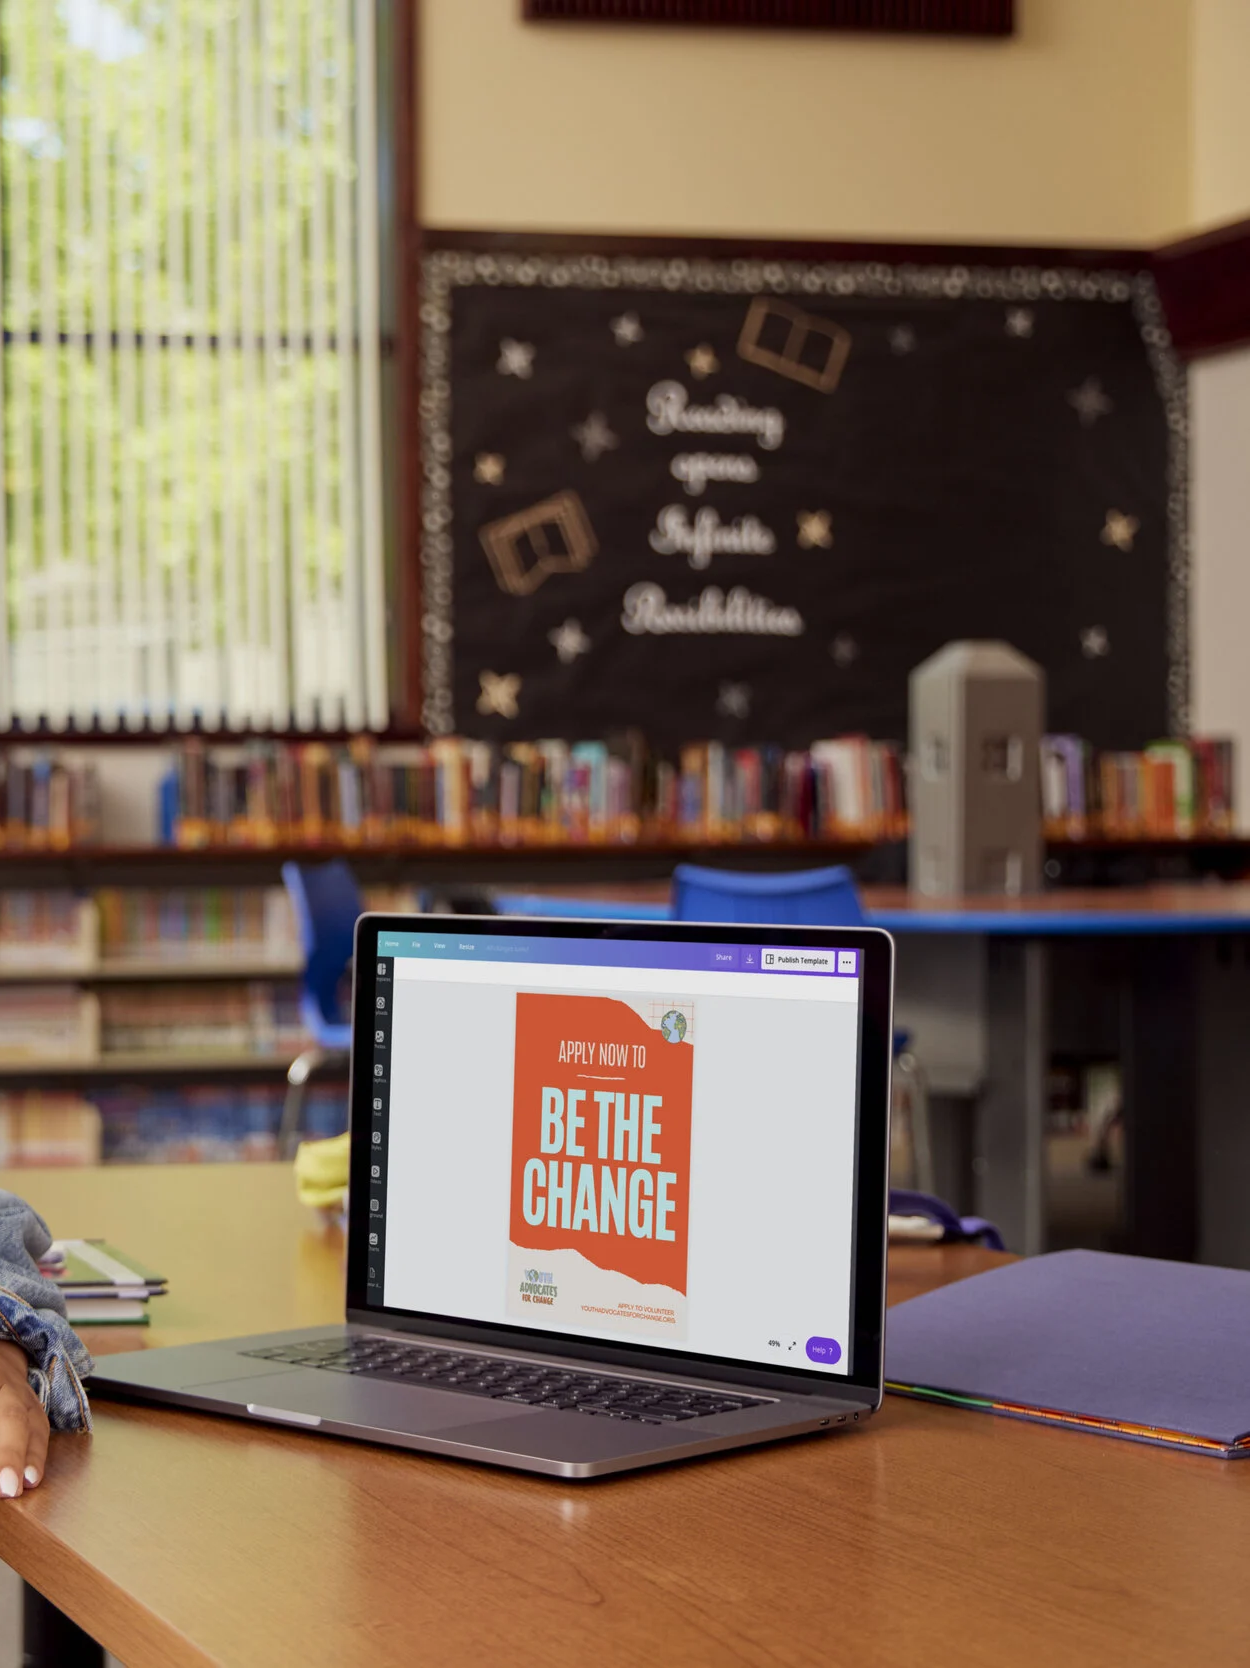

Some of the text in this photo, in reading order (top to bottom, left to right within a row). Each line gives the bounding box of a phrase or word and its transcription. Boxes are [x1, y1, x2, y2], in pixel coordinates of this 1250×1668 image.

[778, 956, 828, 966] Publish Template
[558, 1040, 646, 1069] APPLY NOW TO
[540, 1086, 663, 1165] BE THE
[522, 1157, 677, 1242] CHANGE
[519, 1281, 558, 1298] ADVOCATES
[522, 1293, 554, 1305] FOR CHANGE
[581, 1305, 676, 1324] YOUTHADVOCATESFORCHANGE.ORG
[643, 1306, 675, 1316] VOLUNTEER
[768, 1339, 781, 1348] 49%
[812, 1346, 826, 1356] Help
